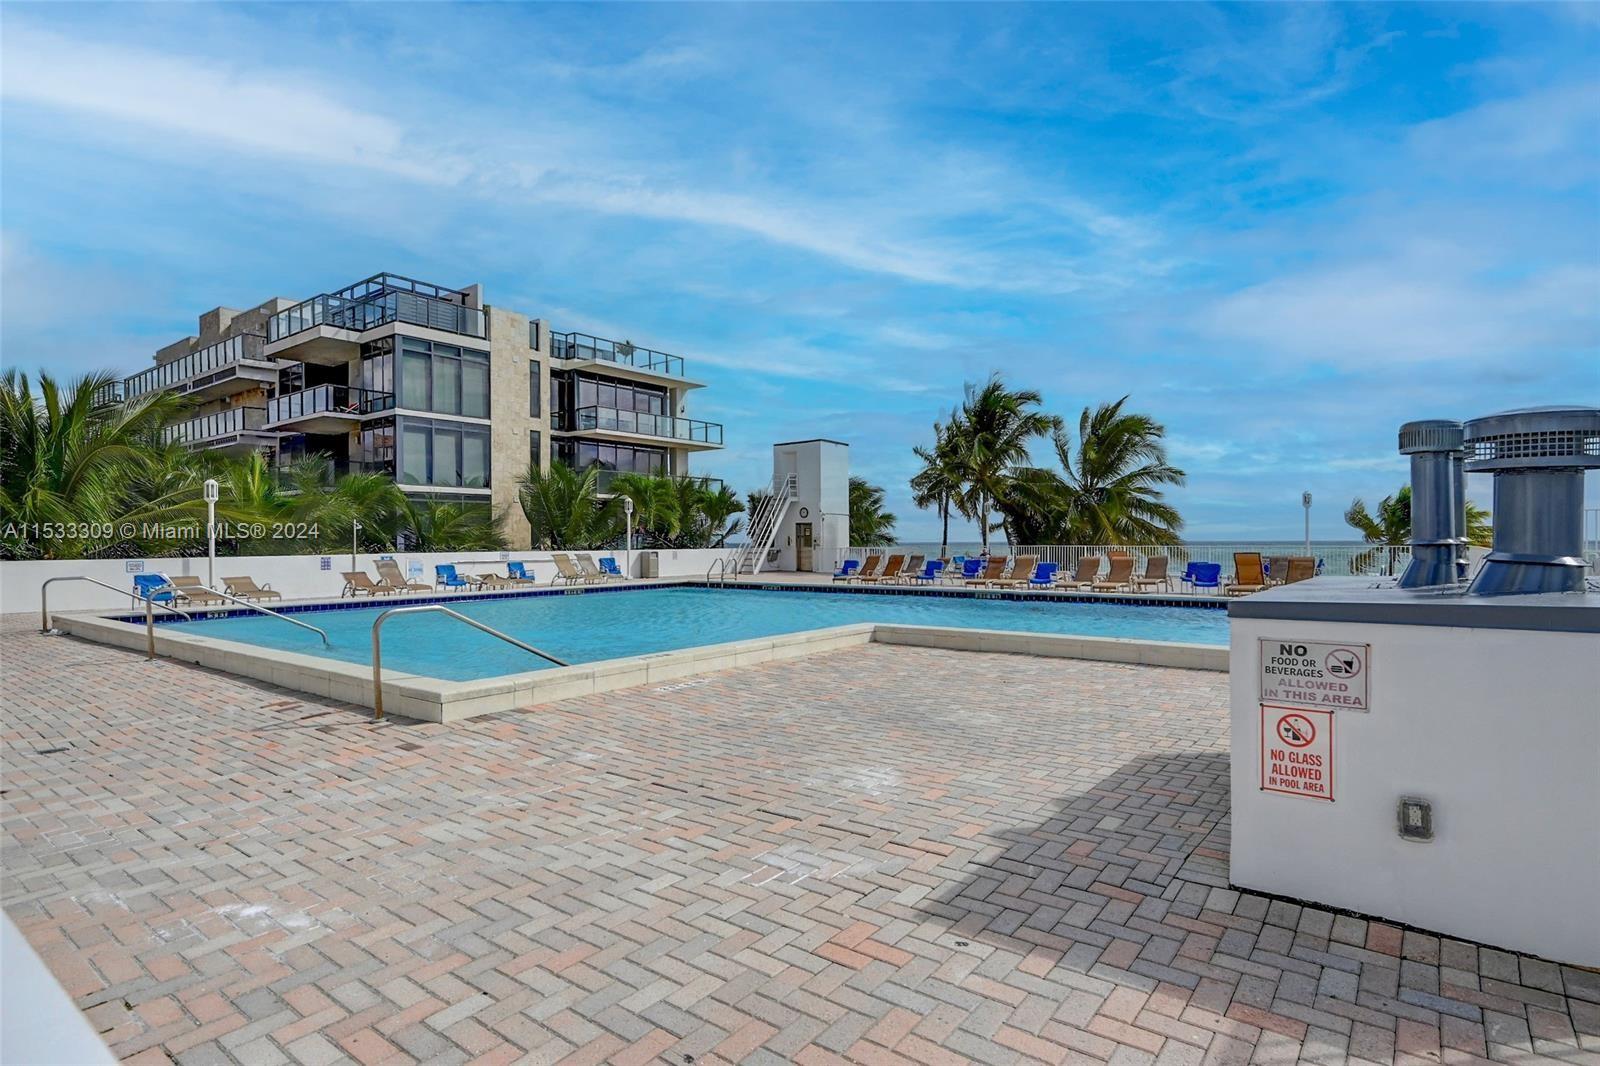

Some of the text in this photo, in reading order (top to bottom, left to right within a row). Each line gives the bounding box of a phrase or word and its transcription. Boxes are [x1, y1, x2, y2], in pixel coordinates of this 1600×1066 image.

[1279, 643, 1307, 657] NO
[1271, 656, 1316, 667] FOOD OR
[1265, 665, 1324, 678] BEVERAGES
[1278, 678, 1348, 692] ALLOWED
[1264, 688, 1363, 706] IN THIS AREA
[1270, 749, 1322, 767] NO GLASS
[1272, 763, 1322, 781] ALLOWED
[1268, 776, 1325, 793] IN POOL AREA
